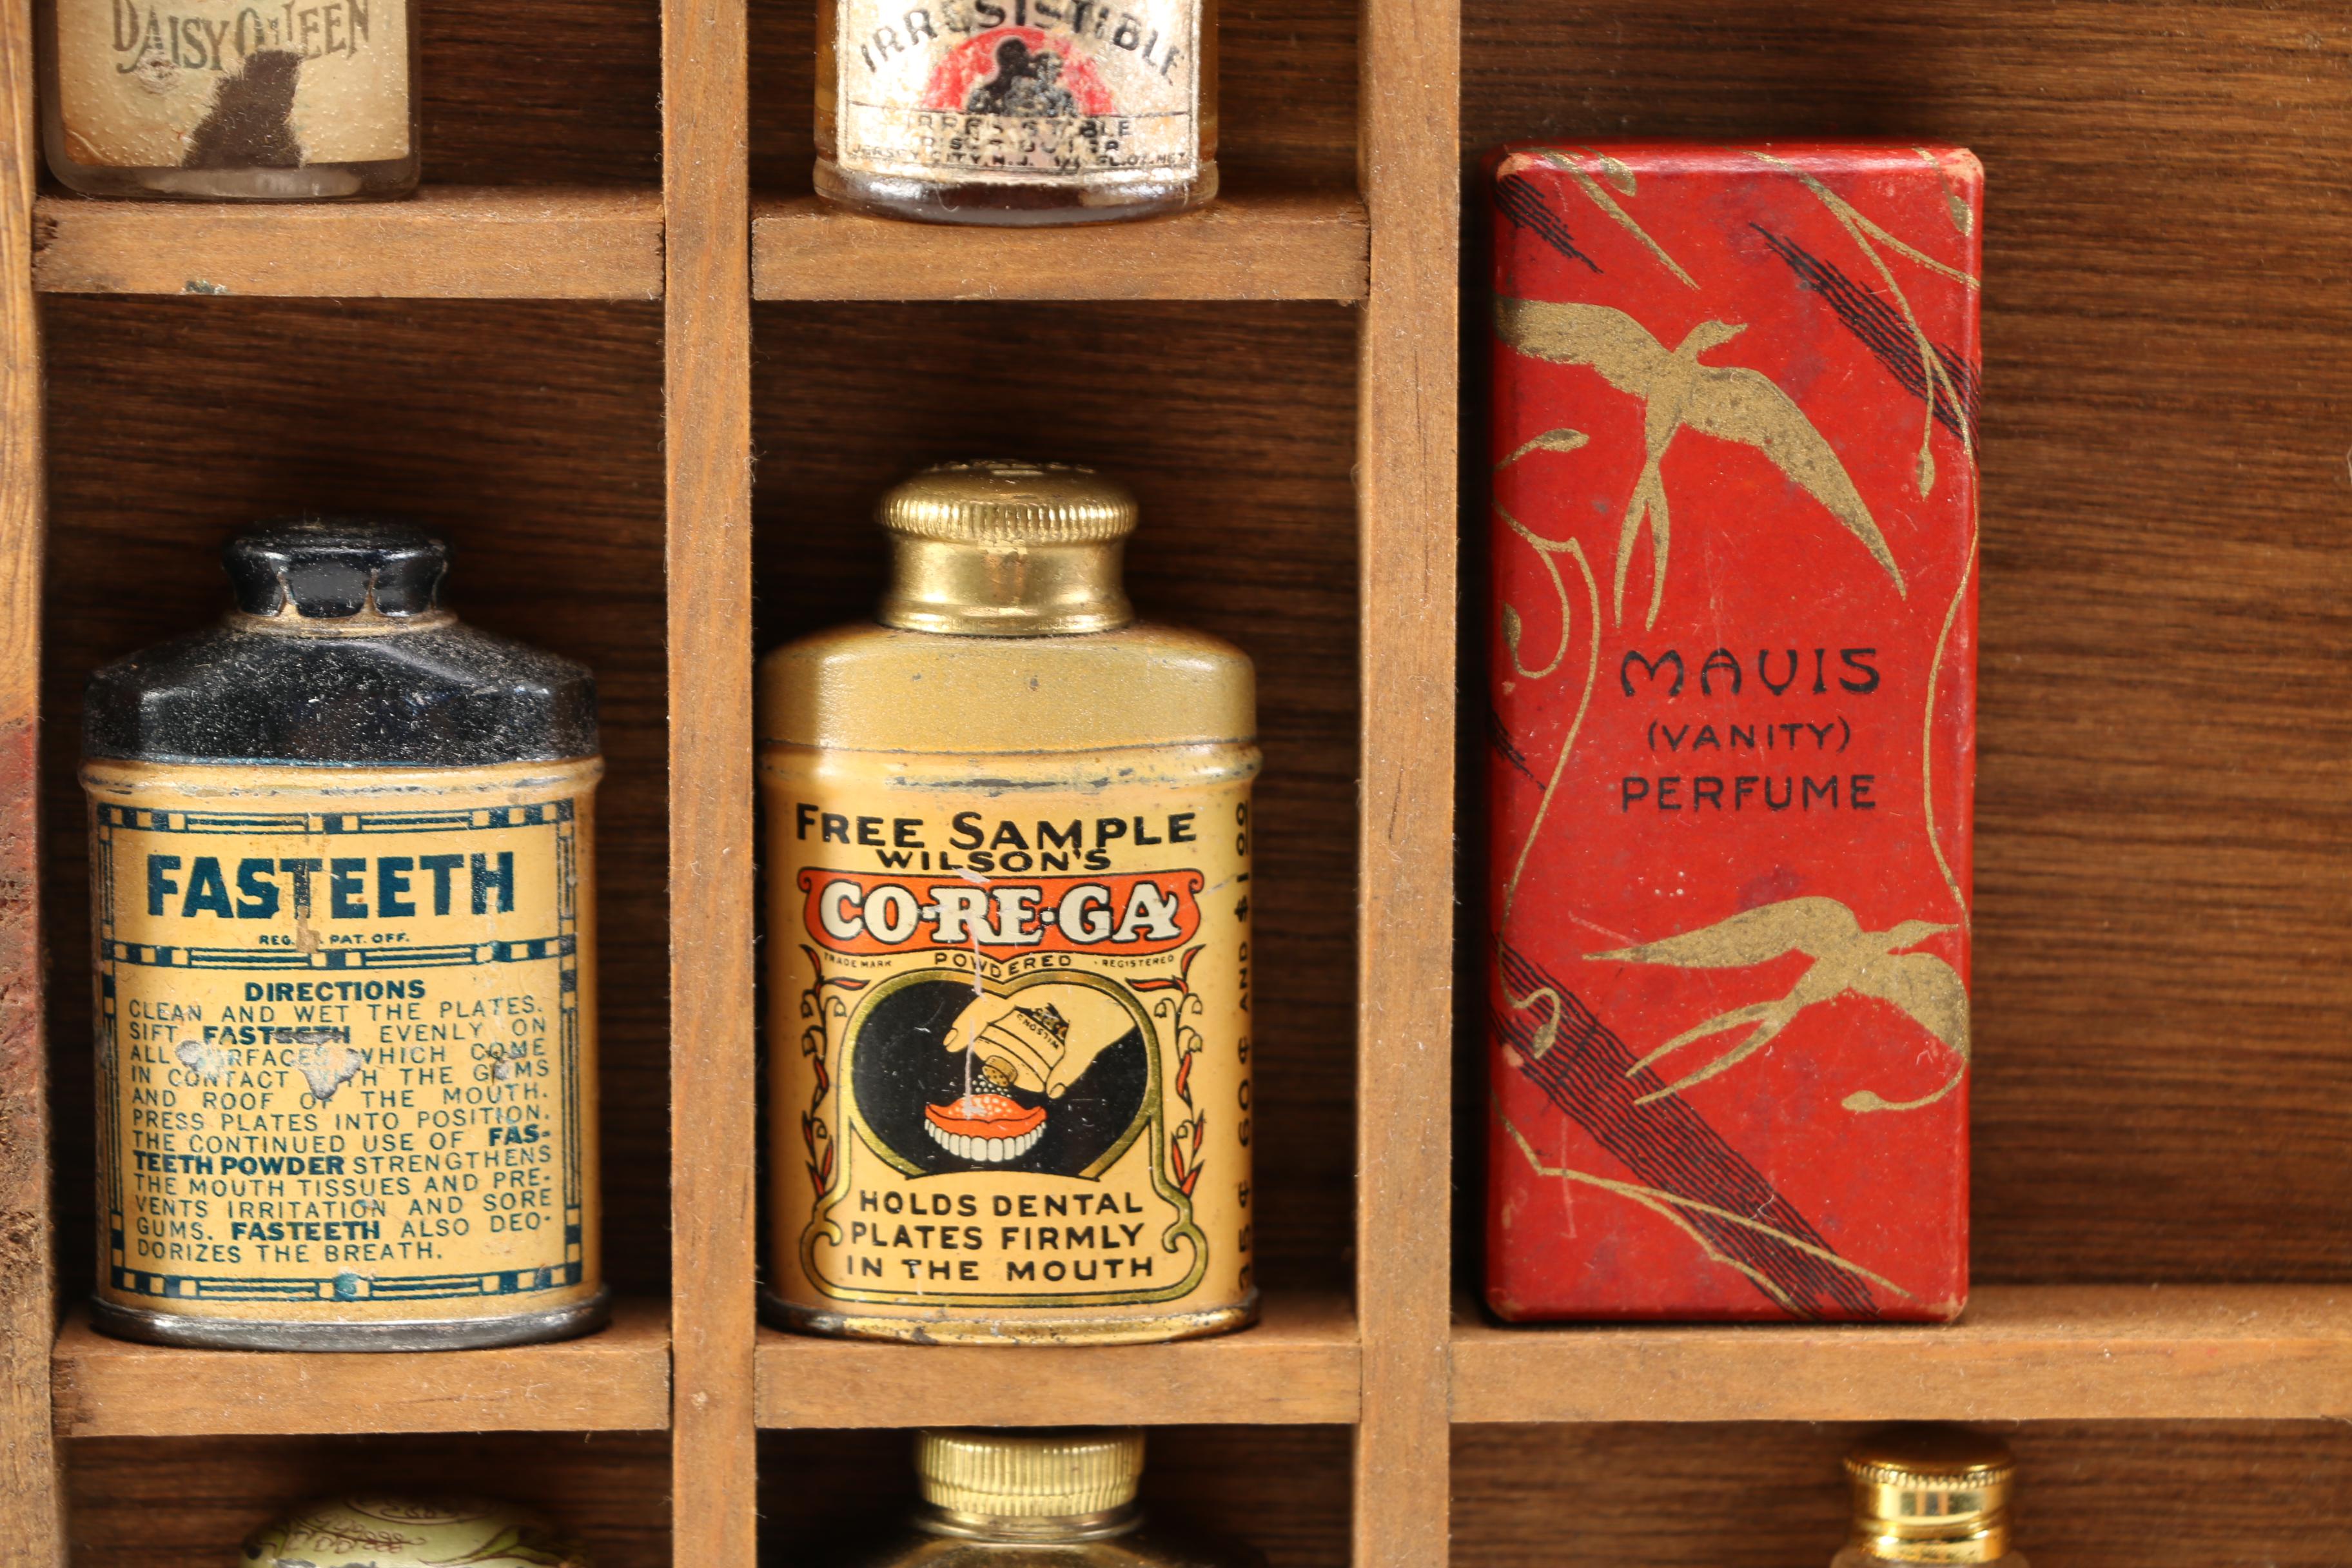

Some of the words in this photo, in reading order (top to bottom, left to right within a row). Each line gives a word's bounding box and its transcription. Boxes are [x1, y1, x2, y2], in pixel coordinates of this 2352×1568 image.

[112, 0, 230, 74] DAISY
[1620, 647, 1881, 697] MAVIS
[1647, 716, 1851, 754] (VANITY)
[1621, 775, 1876, 813] PERFUME
[796, 802, 925, 848] FREE
[950, 810, 1198, 850] SAMPLE
[875, 845, 1112, 872] WILSON'S
[146, 851, 514, 920] FASTEETH
[259, 934, 295, 946] REG.
[329, 934, 367, 944] PAT.
[371, 932, 410, 943] OFF.
[824, 952, 858, 968] TRADE
[934, 952, 1072, 978] POWDERED
[1101, 954, 1174, 968] REGISTERED
[244, 979, 426, 1002] DIRECTIONS
[1239, 941, 1248, 1012] AND
[130, 999, 202, 1022] CLEAN
[221, 1006, 275, 1023] AND
[294, 1005, 349, 1023] WET
[367, 1003, 420, 1021] THE
[440, 995, 543, 1018] PLATES.
[130, 1022, 177, 1043] SIFT
[380, 1022, 483, 1043] EVENLY
[512, 1017, 545, 1036] ON
[130, 1044, 170, 1064] ALL
[132, 1066, 151, 1084] IN
[168, 1068, 289, 1089] CONTACT
[399, 1066, 453, 1086] THE
[473, 1059, 549, 1082] GMS
[132, 1088, 176, 1108] AND
[202, 1092, 274, 1111] ROOF
[360, 1090, 415, 1108] THE
[442, 1082, 548, 1104] MOUTH.
[133, 1108, 204, 1131] PRESS
[221, 1113, 318, 1132] PLATES
[335, 1112, 399, 1130] INTO
[417, 1104, 549, 1128] POSITION.
[133, 1130, 175, 1152] THE
[188, 1133, 345, 1153] CONTINUED
[363, 1132, 414, 1153] USE
[429, 1130, 464, 1150] OF
[489, 1124, 551, 1146] FAS-
[133, 1150, 213, 1175] TEETH
[220, 1155, 345, 1176] POWDER
[353, 1144, 551, 1175] STRENGTHENS
[133, 1173, 177, 1195] THE
[189, 1178, 284, 1197] MOUTH
[297, 1177, 411, 1197] TISSUES
[424, 1173, 478, 1193] AND
[493, 1168, 551, 1189] PRE-
[135, 1194, 208, 1219] VENTS
[228, 1199, 386, 1219] IRRITATION
[408, 1196, 463, 1215] AND
[483, 1188, 551, 1211] SORE
[859, 1190, 977, 1217] HOLDS
[993, 1191, 1143, 1217] DENTAL
[136, 1217, 213, 1240] GUMS.
[231, 1220, 380, 1241] FASTEETH
[400, 1218, 470, 1238] ALSO
[851, 1221, 983, 1251] PLATES
[1001, 1222, 1145, 1251] FIRMLY
[137, 1239, 242, 1263] DORIZES
[255, 1244, 309, 1263] THE
[324, 1242, 442, 1262] BREATH.
[847, 1256, 883, 1277] IN
[902, 1259, 980, 1281] THE
[1006, 1256, 1153, 1282] MOUTH
